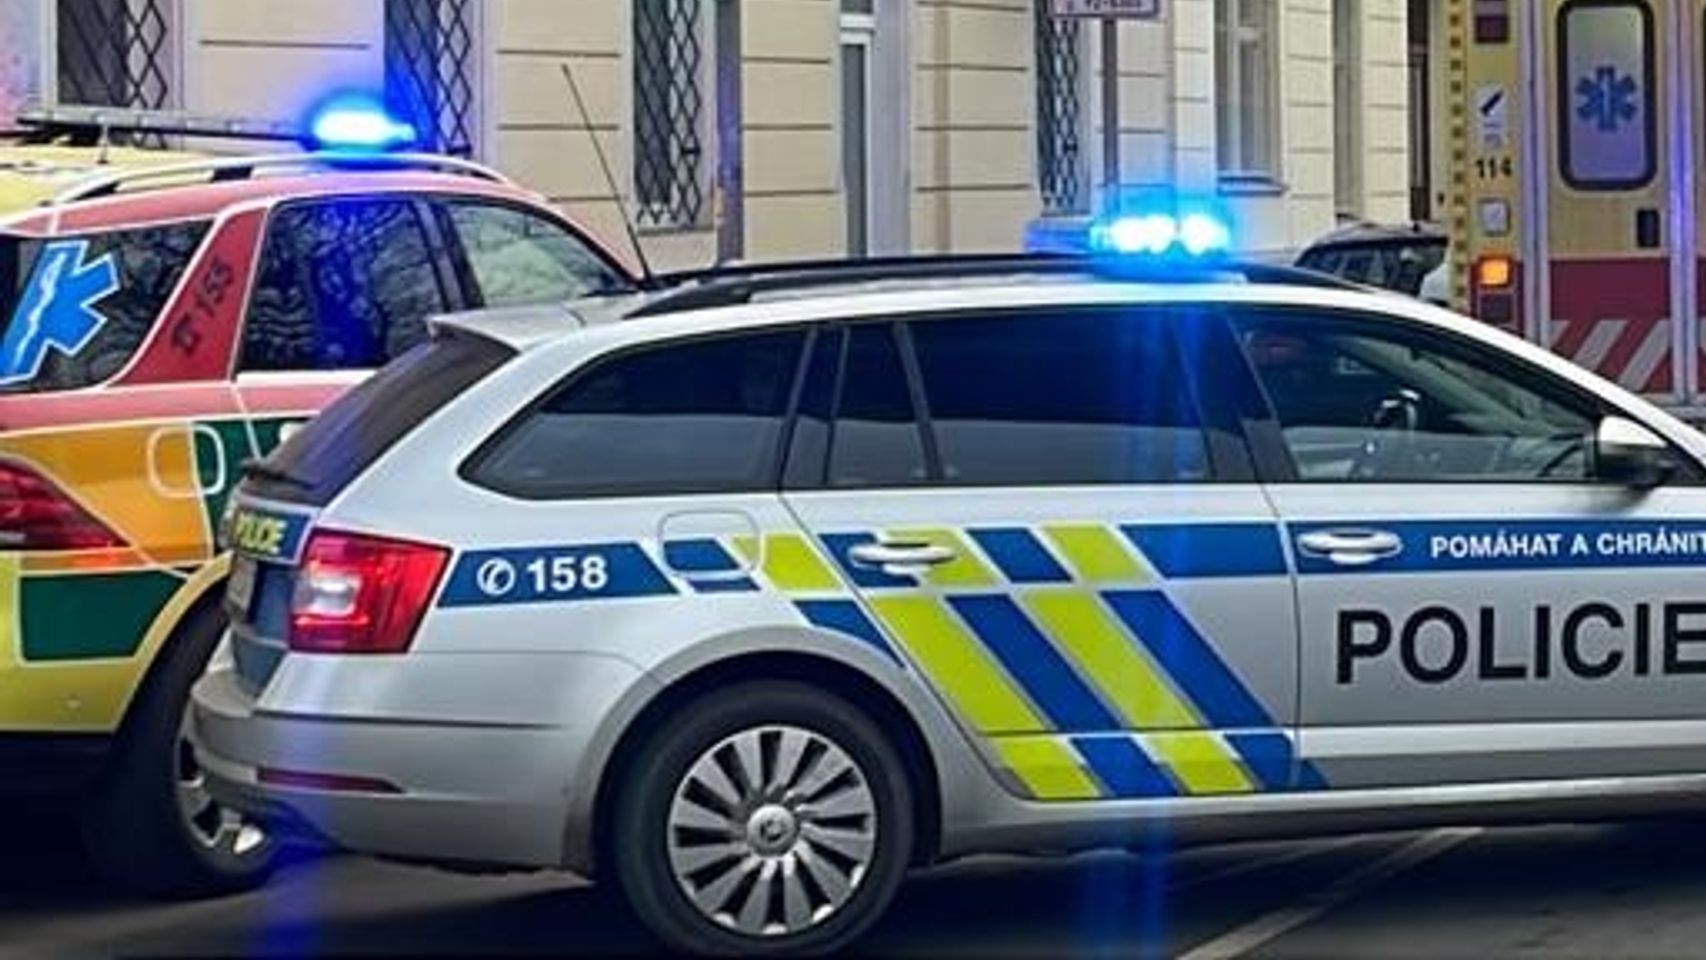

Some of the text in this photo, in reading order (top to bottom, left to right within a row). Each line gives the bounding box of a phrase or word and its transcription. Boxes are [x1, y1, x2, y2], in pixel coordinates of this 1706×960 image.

[1431, 530, 1560, 559] POMÁHAT
[1570, 533, 1590, 555] A
[526, 555, 609, 593] 158
